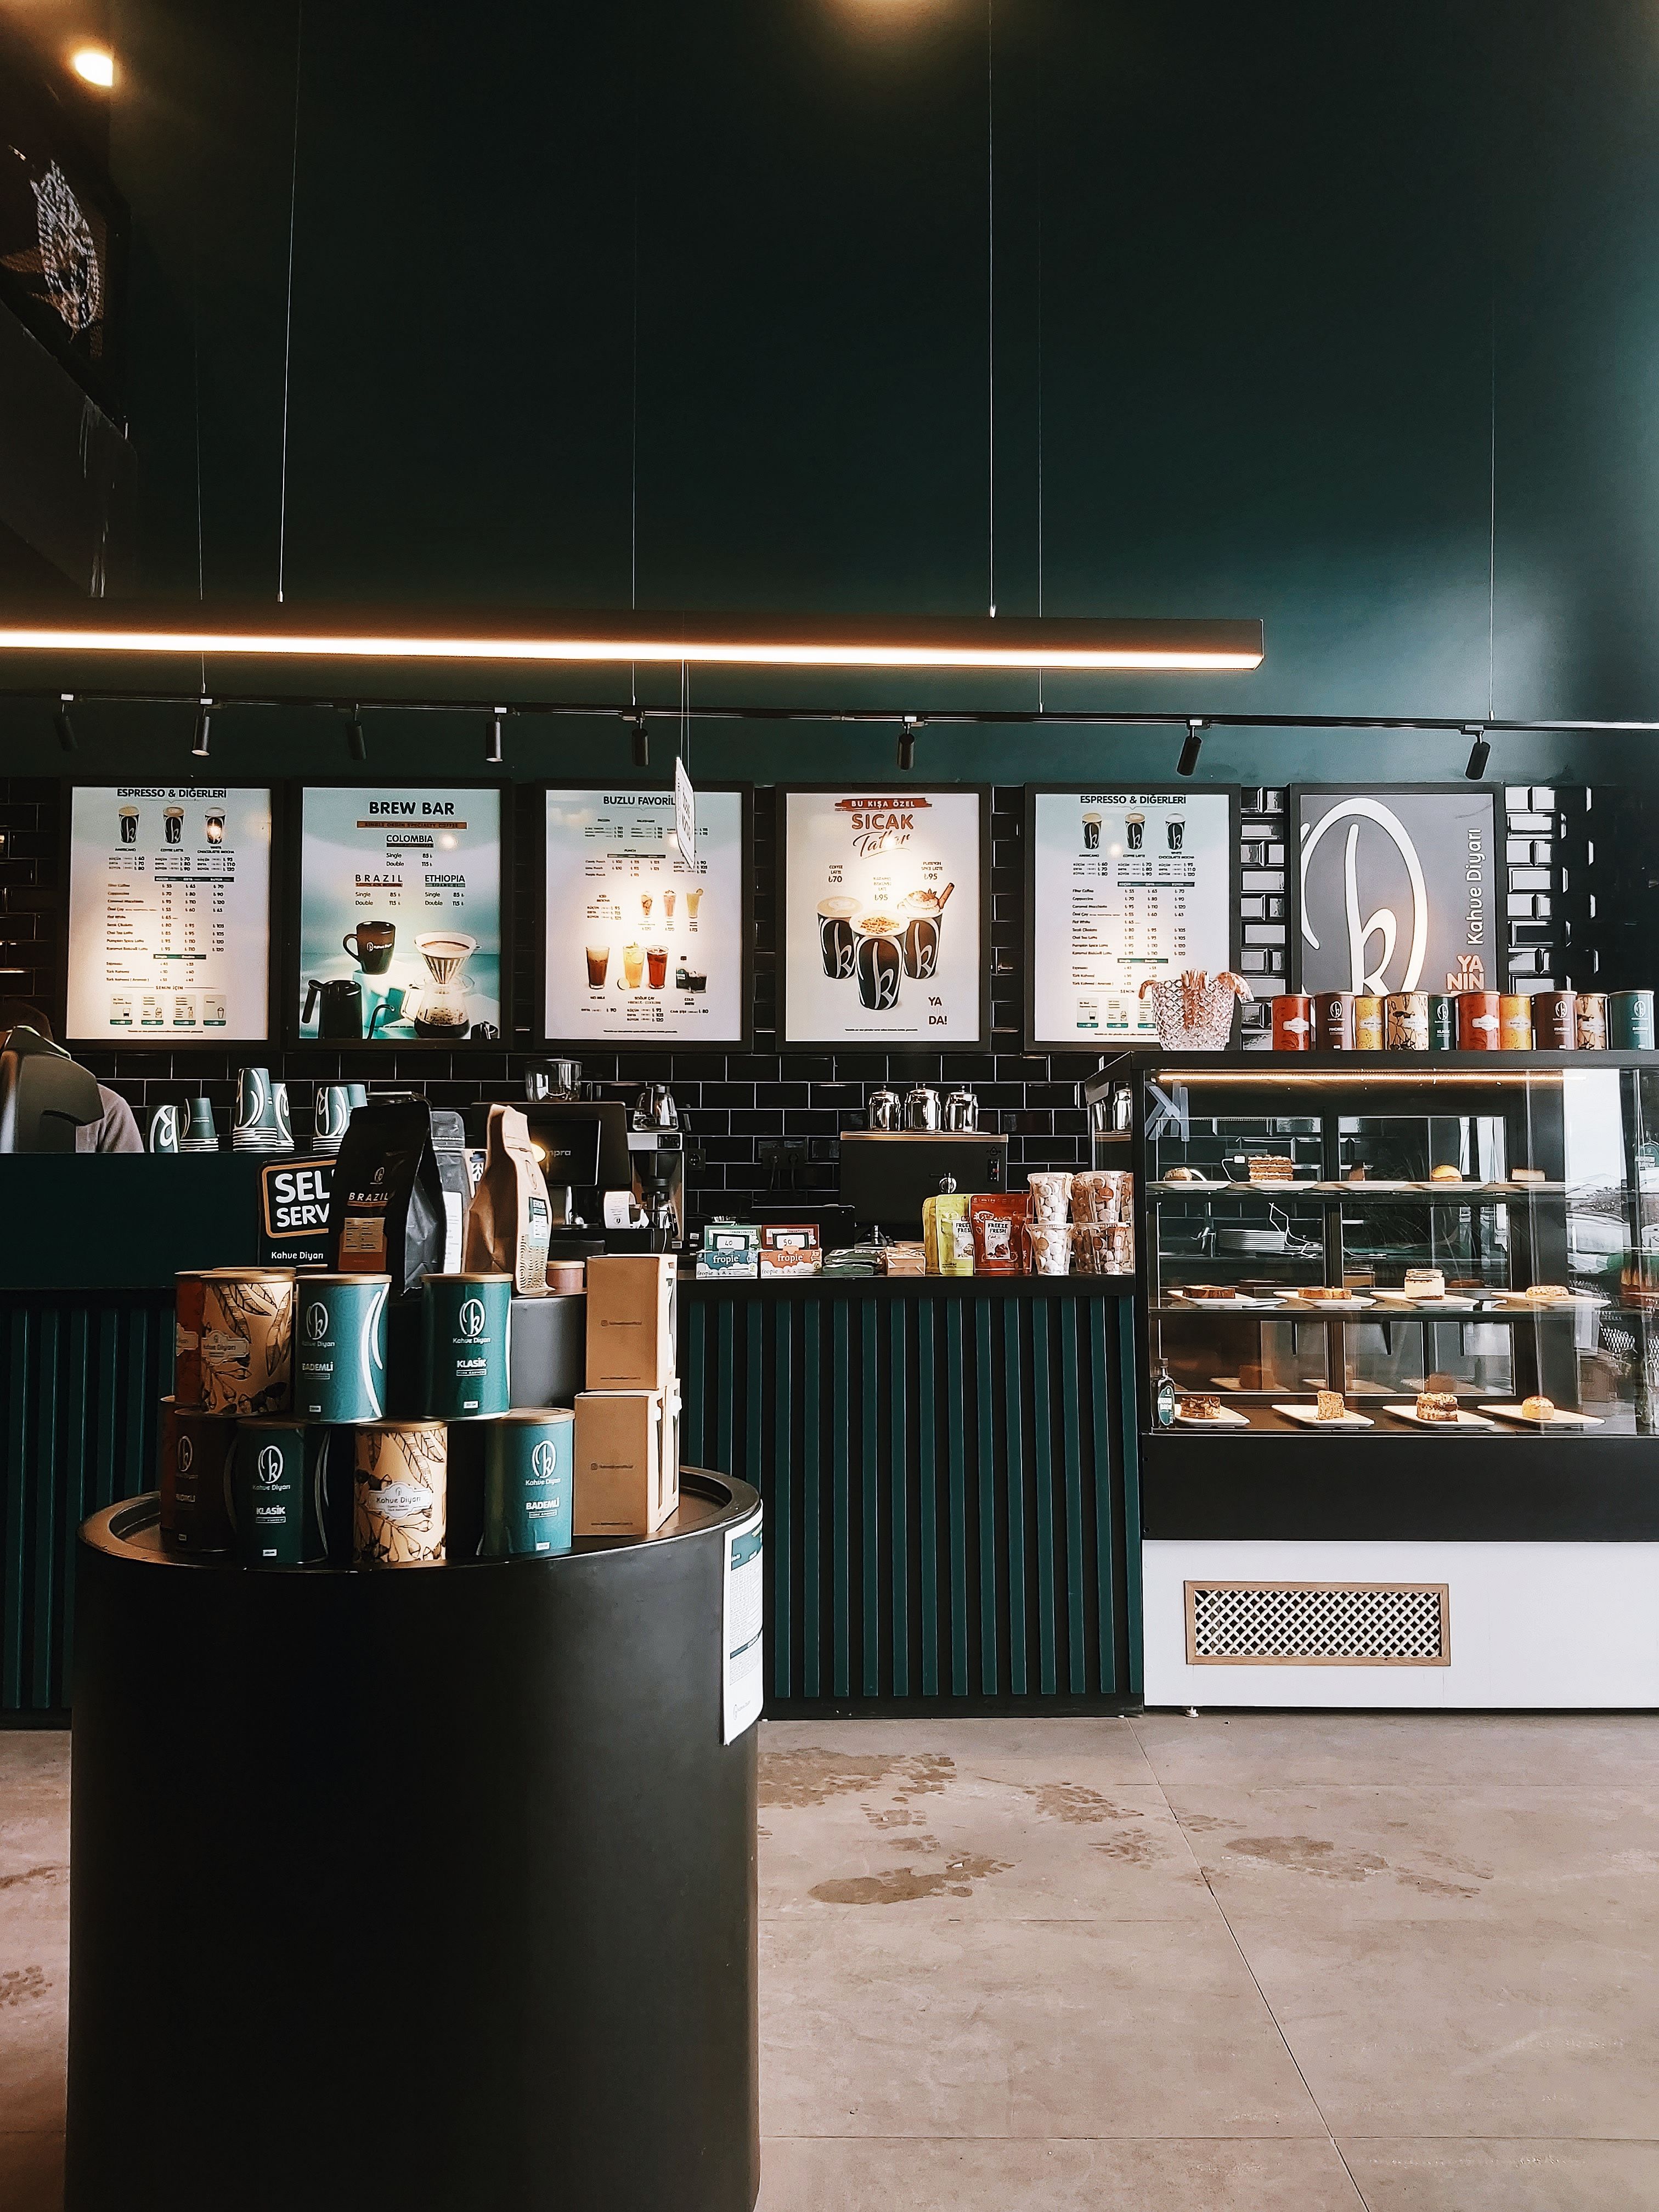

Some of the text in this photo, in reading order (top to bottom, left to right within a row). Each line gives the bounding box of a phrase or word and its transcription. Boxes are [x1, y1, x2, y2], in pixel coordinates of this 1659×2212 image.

[117, 789, 165, 797] ESPRESSO
[603, 795, 675, 805] BUZLU FAVORİL
[1080, 795, 1126, 804] ESPRESSO
[369, 802, 454, 815] BREW BAR
[852, 814, 913, 830] SICAK
[1465, 828, 1486, 945] Kahve Diyarı
[1457, 955, 1485, 973] YA
[1447, 973, 1485, 990] NIN
[928, 997, 943, 1006] YA
[929, 1015, 947, 1025] DA!
[275, 1170, 335, 1203] SEL
[349, 1192, 388, 1201] BRAZIL
[276, 1204, 329, 1227] SERV
[713, 1254, 739, 1265] fropie
[777, 1253, 803, 1264] fropie
[457, 1357, 487, 1368] KLASİK
[526, 1497, 560, 1510] BADEMLİ
[256, 1505, 285, 1514] KLASİK
